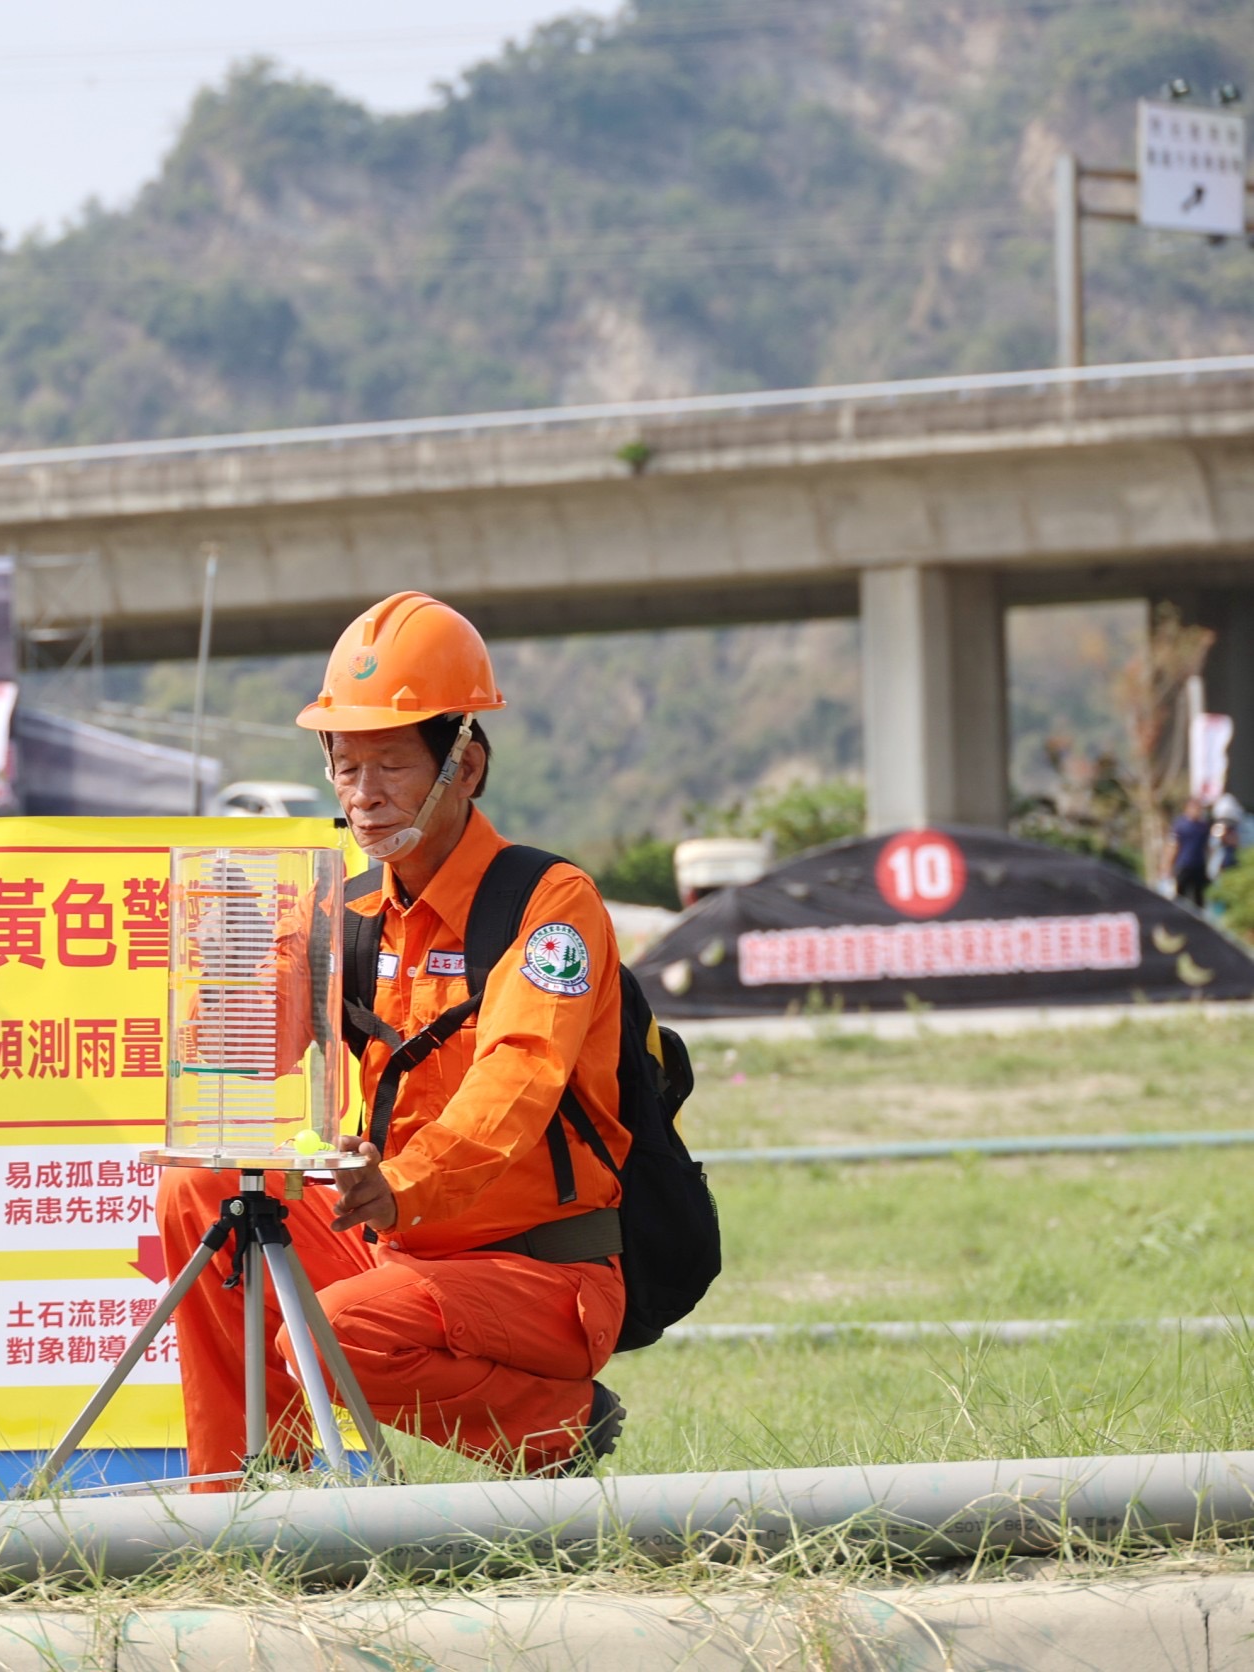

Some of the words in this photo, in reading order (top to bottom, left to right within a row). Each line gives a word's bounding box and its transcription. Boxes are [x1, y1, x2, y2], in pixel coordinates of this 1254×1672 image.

[887, 843, 953, 901] 10
[5, 1160, 163, 1189] 易成孤島地
[4, 1196, 155, 1226] 病患先採外
[6, 1298, 176, 1329] 土石流影響
